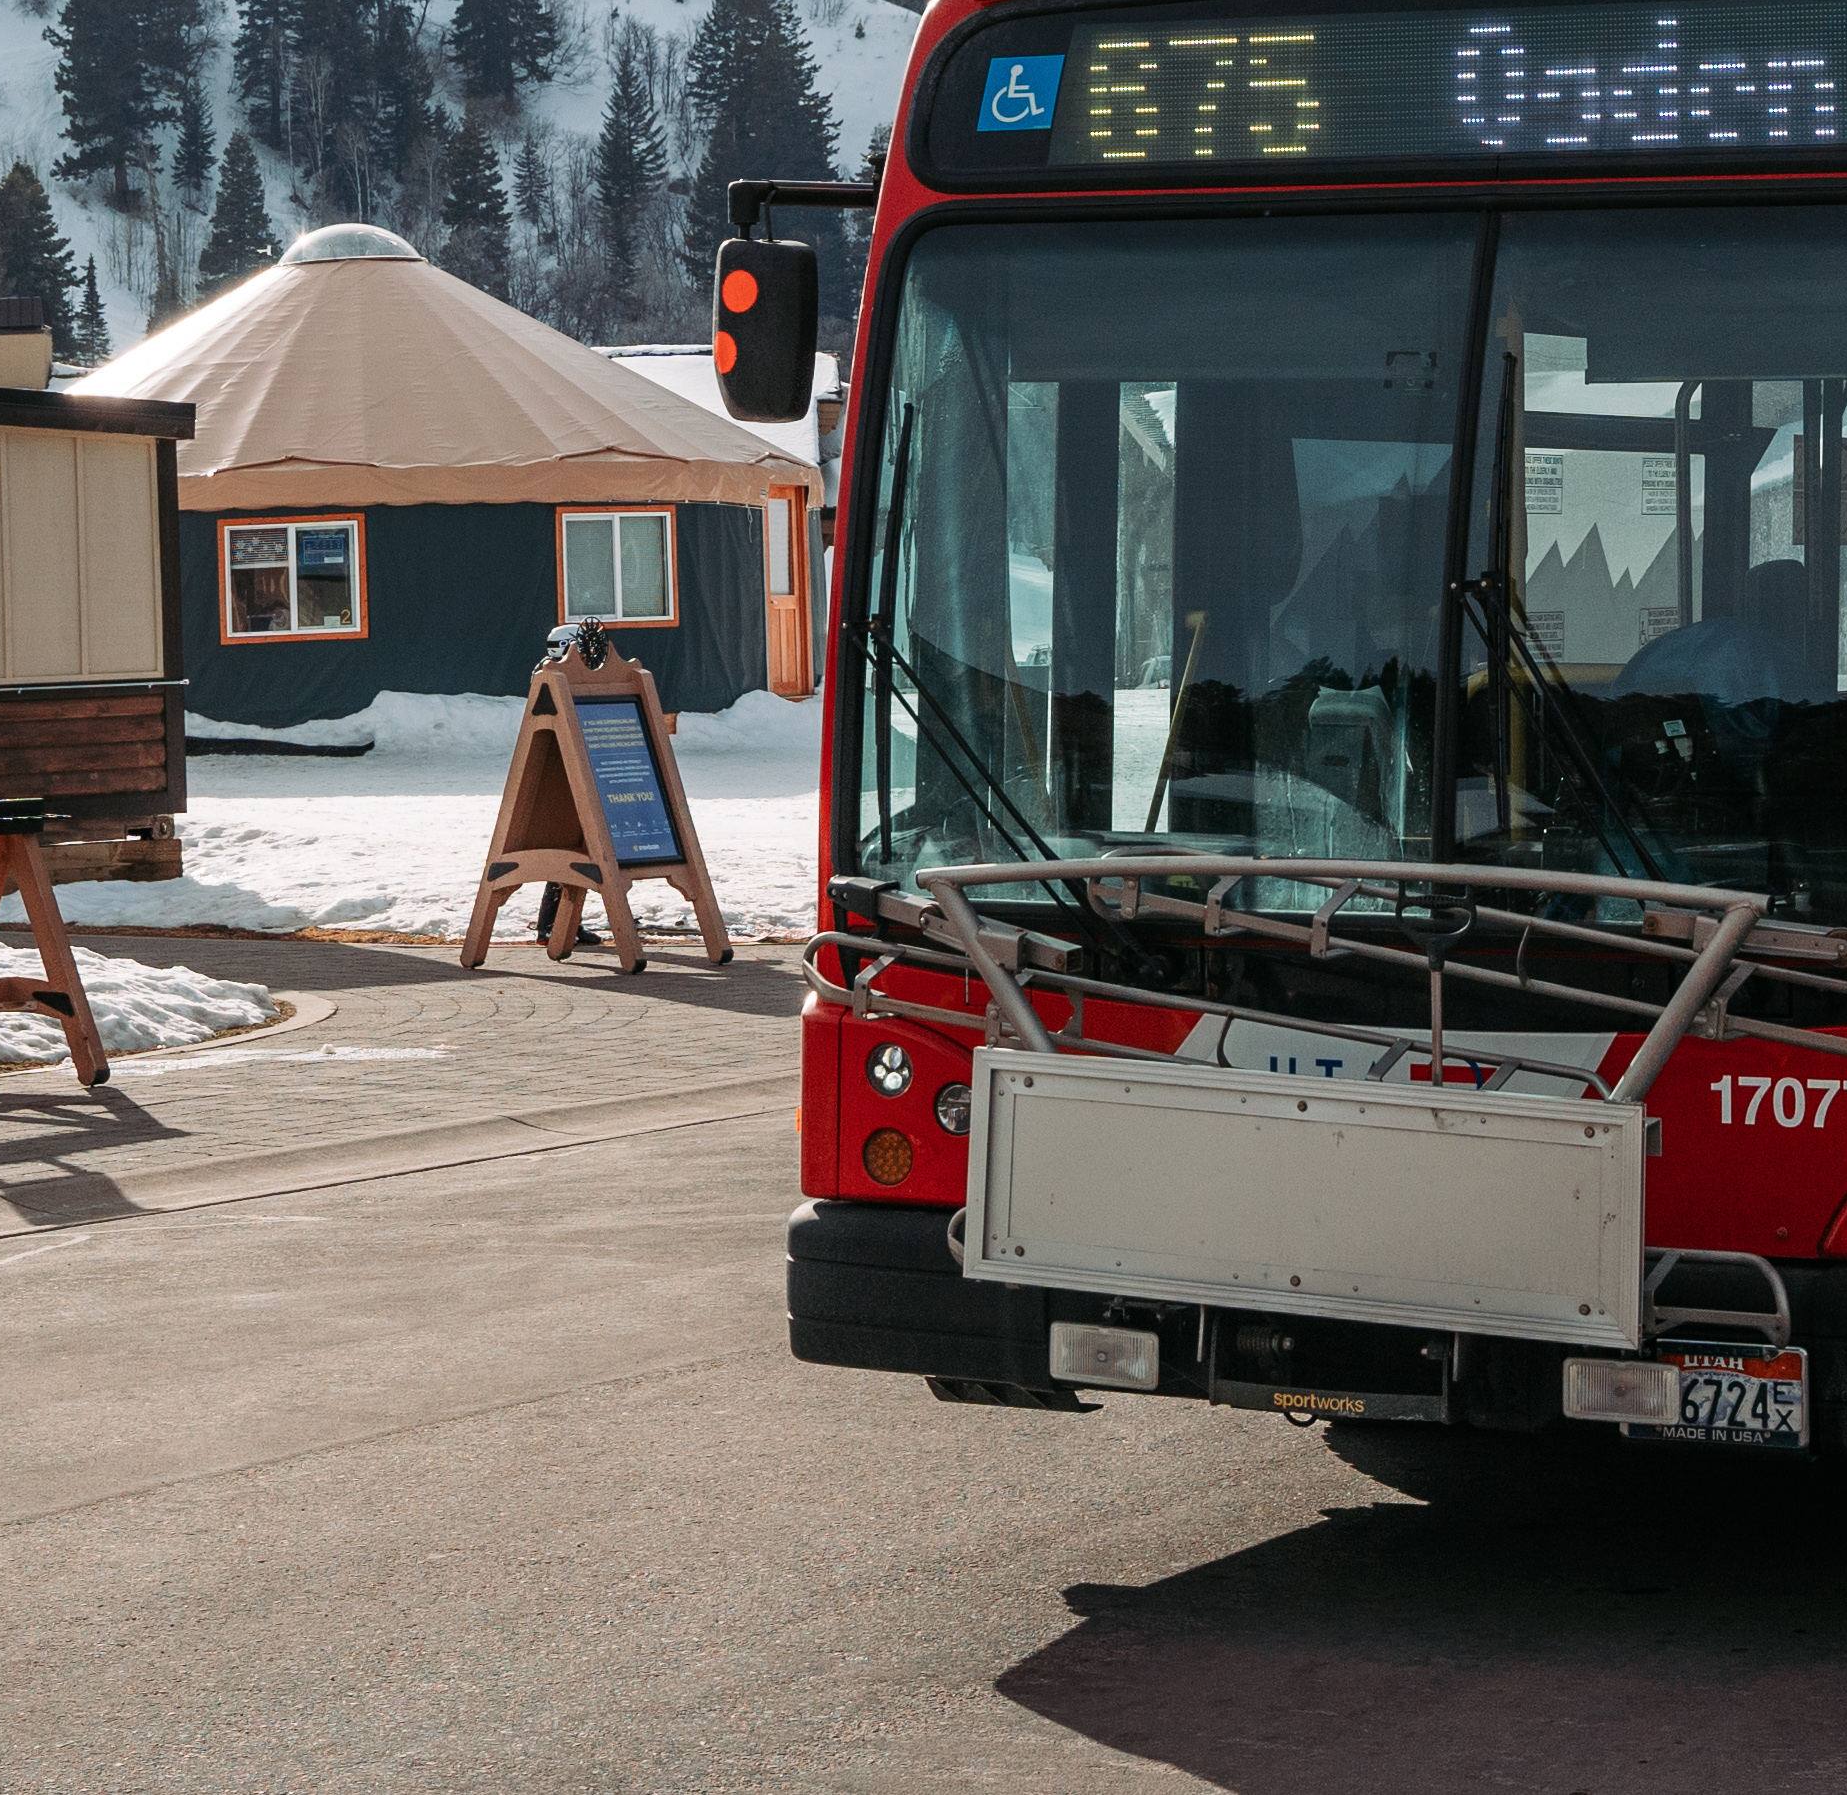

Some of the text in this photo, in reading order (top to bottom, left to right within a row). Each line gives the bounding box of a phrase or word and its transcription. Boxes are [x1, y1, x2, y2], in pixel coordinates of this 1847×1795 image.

[1088, 18, 1836, 159] 675 Ogden
[341, 609, 351, 624] 2
[607, 793, 636, 804] THANK
[1683, 1355, 1745, 1371] UTAH
[1273, 1393, 1366, 1413] sportworks
[1663, 1426, 1765, 1444] MADE IN USA
